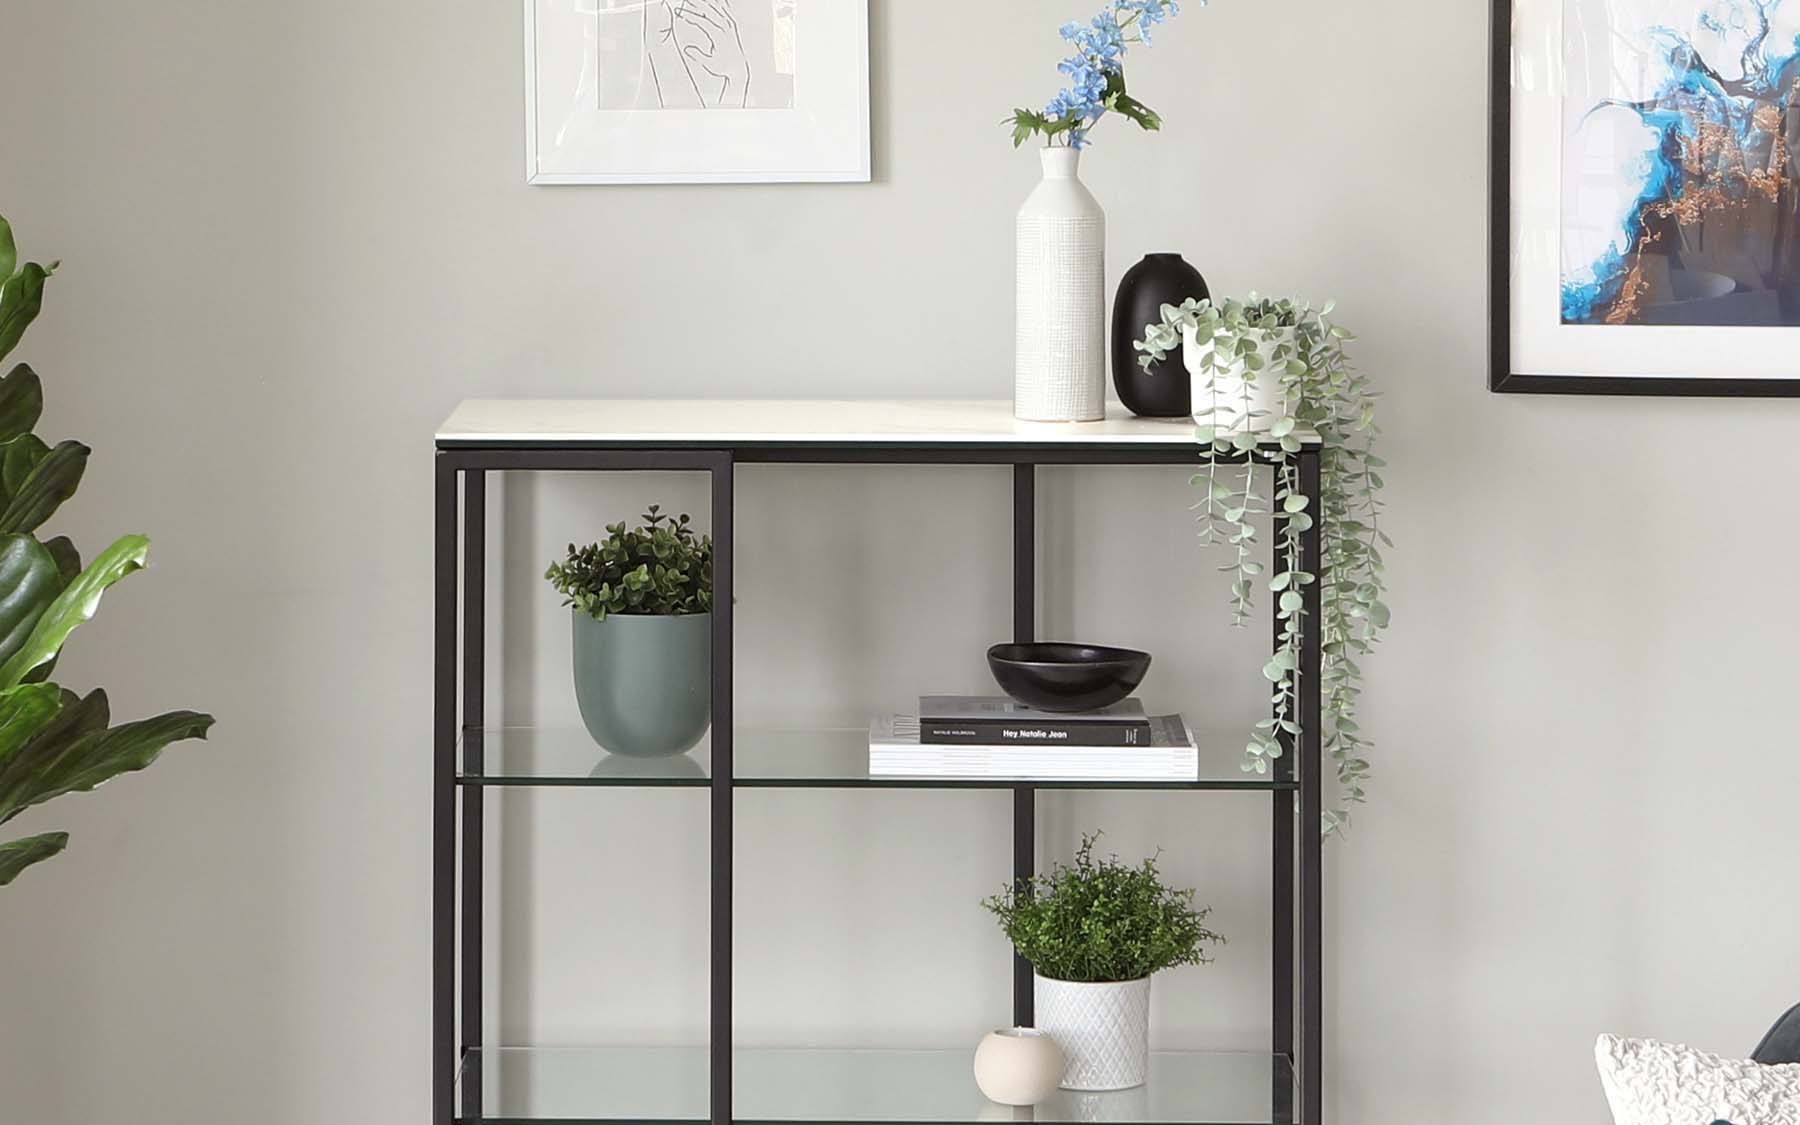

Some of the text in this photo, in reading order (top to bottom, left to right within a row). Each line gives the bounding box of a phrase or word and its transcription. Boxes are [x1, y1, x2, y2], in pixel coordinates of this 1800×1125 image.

[1003, 729, 1068, 739] Hey Natalie Jean
